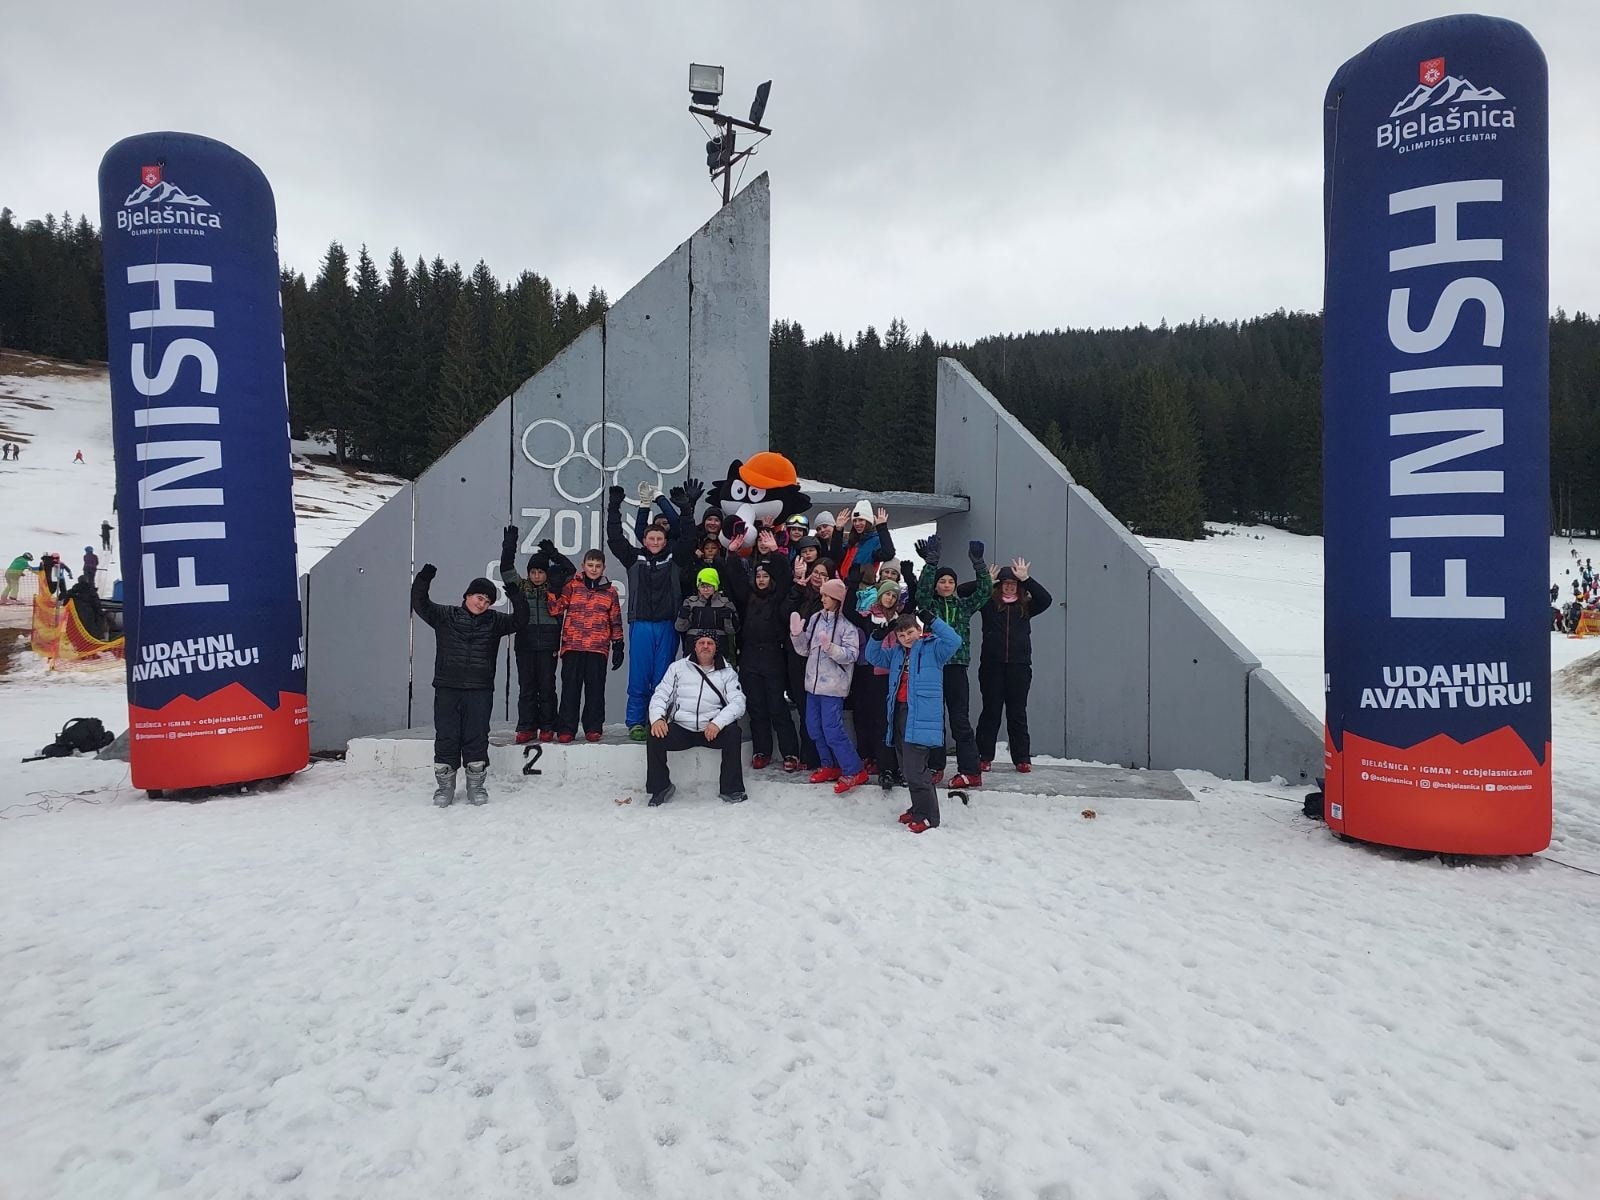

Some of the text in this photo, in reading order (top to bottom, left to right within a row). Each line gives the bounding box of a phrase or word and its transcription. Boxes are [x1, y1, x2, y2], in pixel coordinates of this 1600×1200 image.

[1376, 104, 1516, 150] Bjelašnica
[1398, 132, 1498, 154] OLIMPIJSKI CENTAR
[117, 206, 222, 232] Bjelašnica
[173, 228, 205, 236] CENTAR
[1387, 179, 1505, 619] FINISH
[127, 263, 230, 606] FINISH
[141, 633, 235, 663] UDAHNI
[132, 647, 260, 683] AVANTURU!
[1382, 661, 1509, 687] UDAHNI
[1360, 681, 1533, 709] AVANTURU!
[199, 713, 263, 725] ocbjelasnica.com
[523, 744, 542, 775] 2
[1420, 766, 1452, 775] IGMAN
[1463, 768, 1533, 778] ocbjelasnica.com
